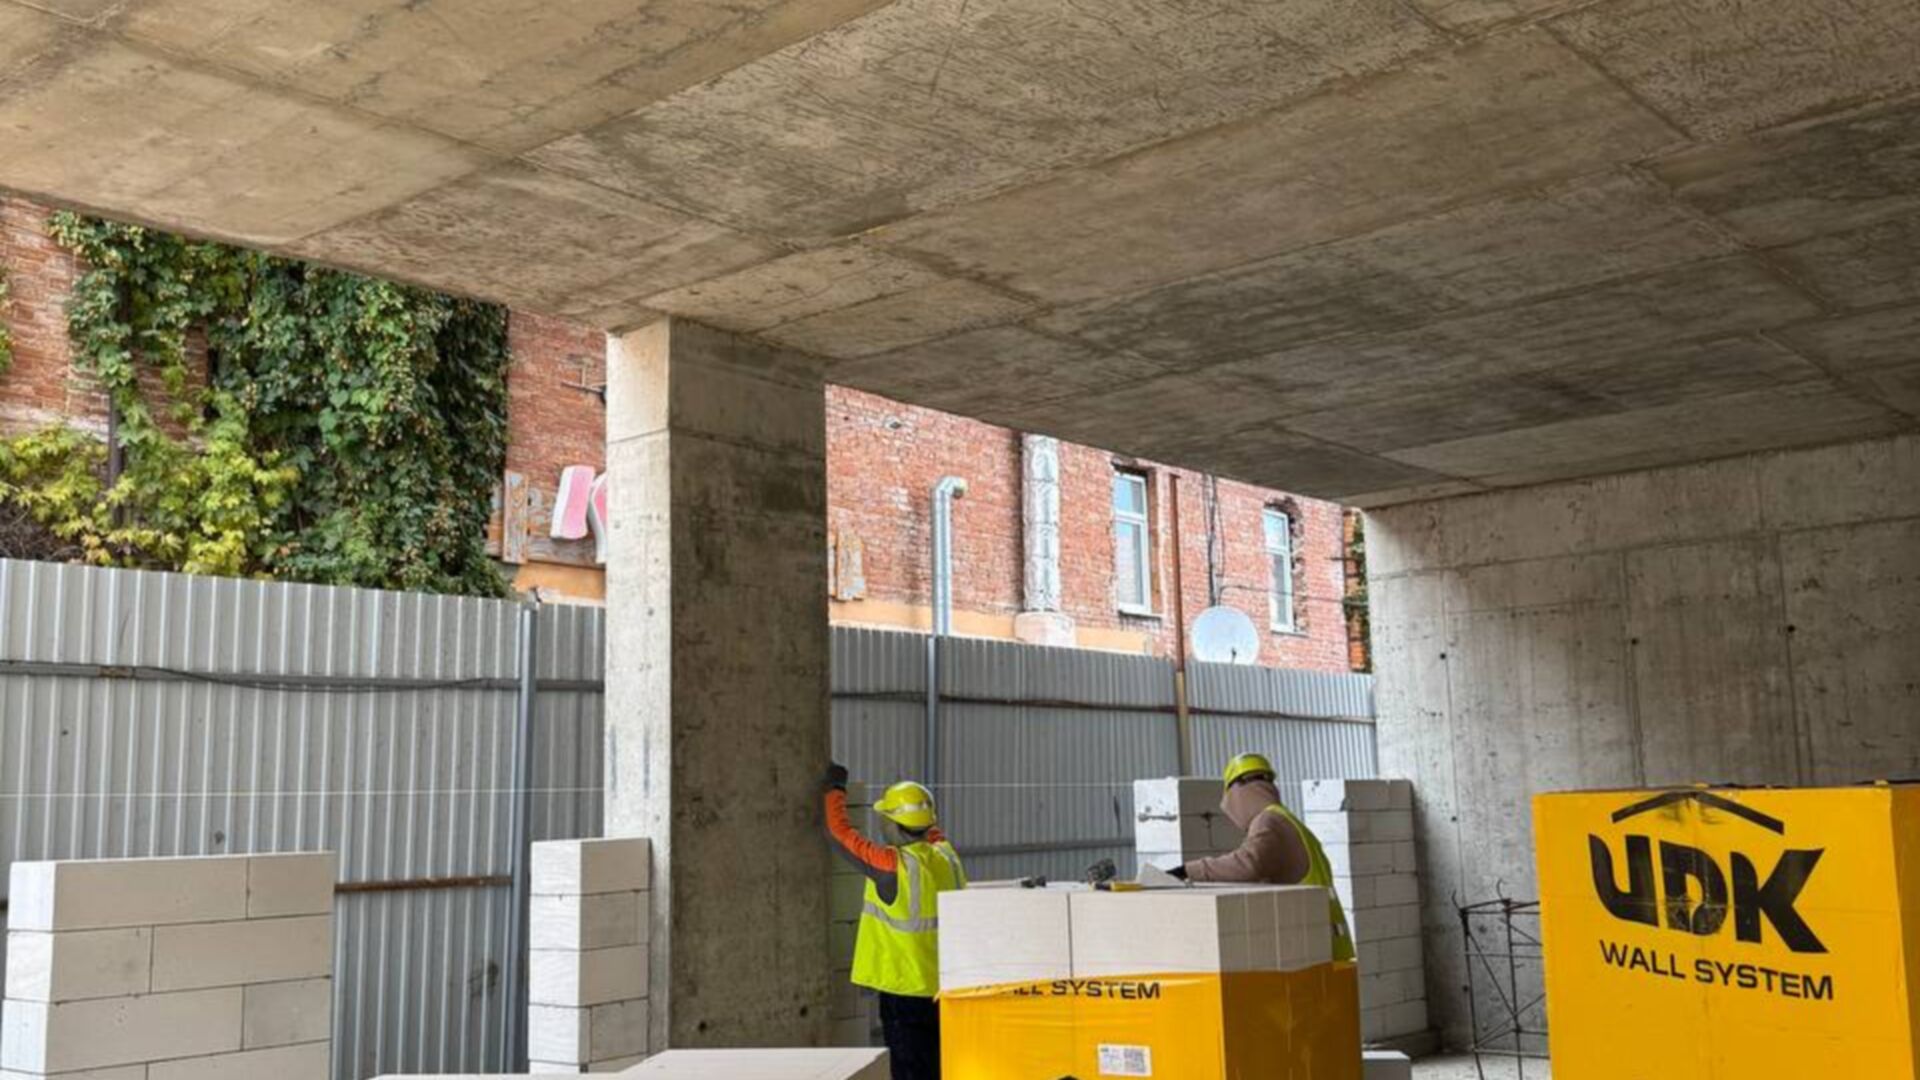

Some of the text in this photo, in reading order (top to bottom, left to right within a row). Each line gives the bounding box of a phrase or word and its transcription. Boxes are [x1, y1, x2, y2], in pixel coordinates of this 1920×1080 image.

[1588, 833, 1829, 953] UDK
[1051, 979, 1160, 1000] SYSTEM
[1599, 938, 1834, 1001] WALL SYSTEM
